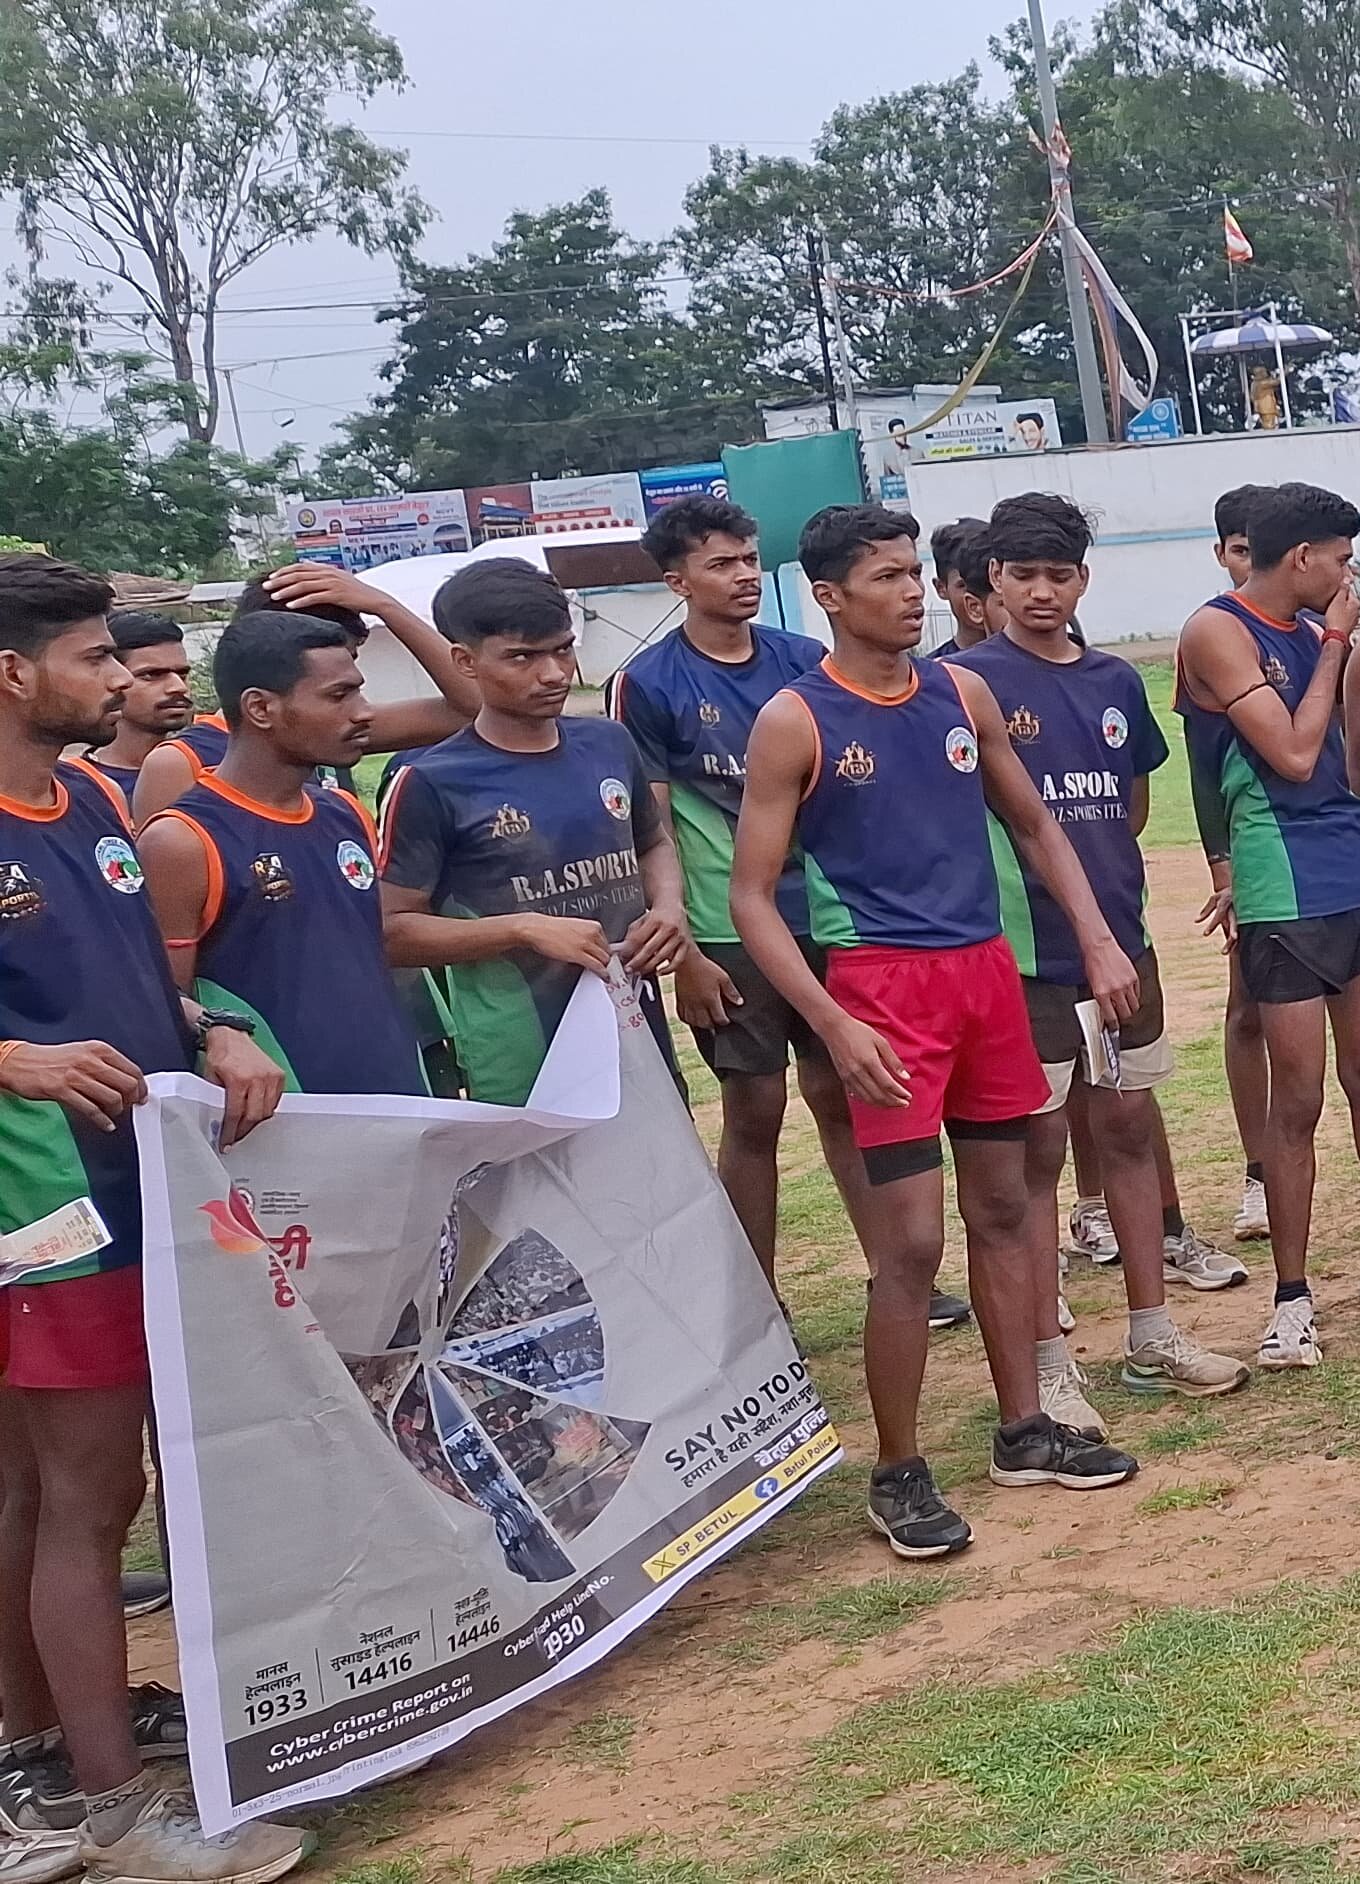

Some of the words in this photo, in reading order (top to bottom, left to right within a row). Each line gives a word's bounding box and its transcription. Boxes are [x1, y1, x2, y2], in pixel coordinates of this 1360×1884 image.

[946, 411, 998, 427] TITAN
[664, 1423, 716, 1473] SAY
[720, 1397, 761, 1433] NO
[758, 1374, 790, 1404] TO
[681, 1456, 718, 1489] हमारा
[715, 1446, 729, 1464] है
[727, 1431, 753, 1454] यही
[359, 1624, 394, 1645] नेशनल
[447, 1614, 500, 1653] 14446
[503, 1627, 536, 1658] Cyber
[551, 1600, 573, 1623] Help
[542, 1613, 586, 1660] 1930
[245, 1671, 301, 1701] हेल्पलाइन
[255, 1662, 289, 1680] मानस
[343, 1651, 413, 1691] 14416
[243, 1688, 308, 1726] 1933
[270, 1728, 330, 1761] Cyber
[333, 1706, 388, 1736] Crime
[392, 1682, 449, 1715] Report
[450, 1672, 472, 1688] on
[266, 1685, 474, 1774] www.cybercrime.gov.in
